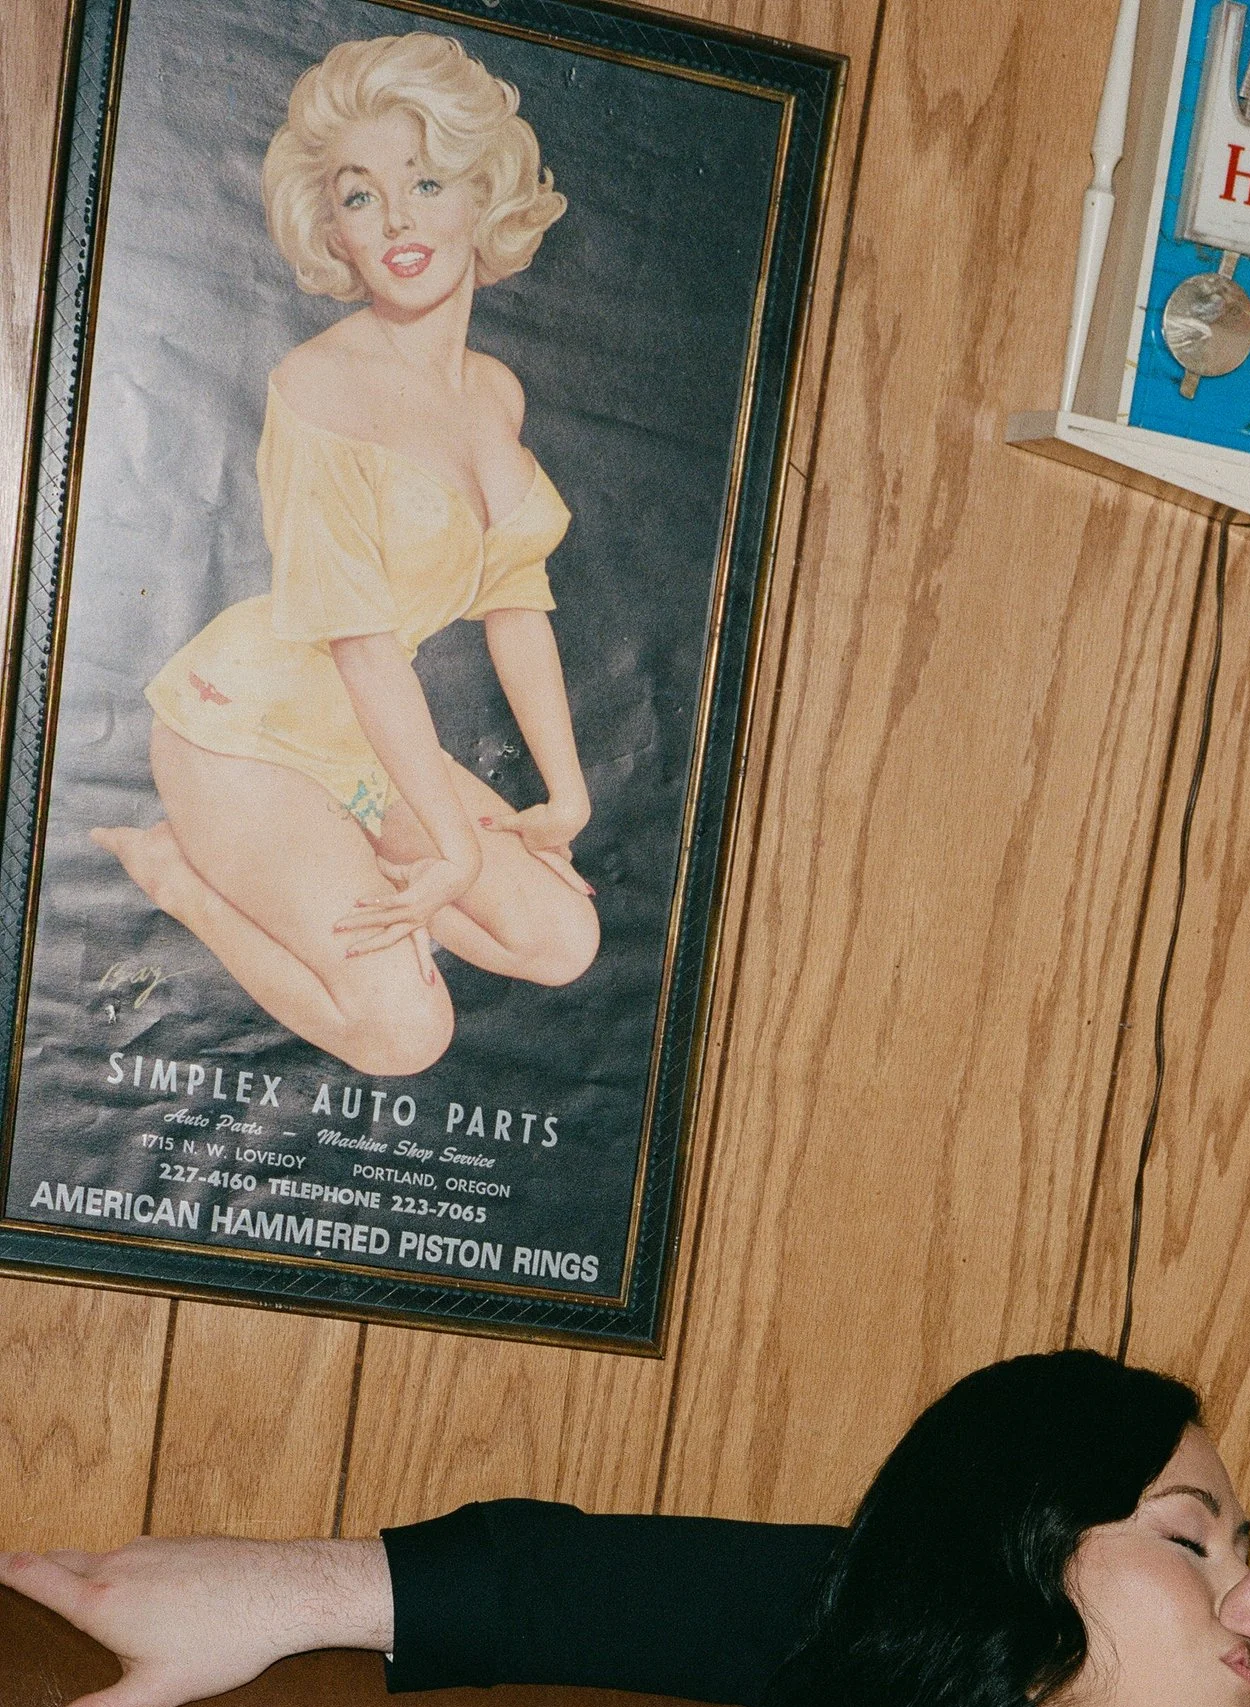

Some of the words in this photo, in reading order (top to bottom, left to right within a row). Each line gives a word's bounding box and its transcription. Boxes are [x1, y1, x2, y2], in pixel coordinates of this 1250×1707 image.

[106, 1052, 282, 1109] SIMPLEX
[311, 1083, 417, 1127] AUTO
[446, 1103, 558, 1147] PARTS
[139, 1132, 174, 1151] 1715
[182, 1139, 199, 1157] N.
[205, 1142, 227, 1161] W.
[235, 1147, 306, 1170] LOVEJOY
[353, 1164, 437, 1190] PORTLAND,
[446, 1176, 510, 1199] OREGON
[163, 1105, 209, 1129] Auto
[215, 1114, 263, 1139] Parts
[317, 1128, 388, 1154] Machine
[393, 1140, 434, 1162] Shop
[439, 1146, 496, 1169] Service
[159, 1162, 258, 1194] 227-4160
[264, 1178, 381, 1209] TELEPHONE
[391, 1195, 486, 1223] 223-7065
[30, 1181, 200, 1230] AMERICAN
[211, 1204, 390, 1252] HAMMERED
[399, 1231, 503, 1271] PISTON
[513, 1246, 599, 1282] RINGS
